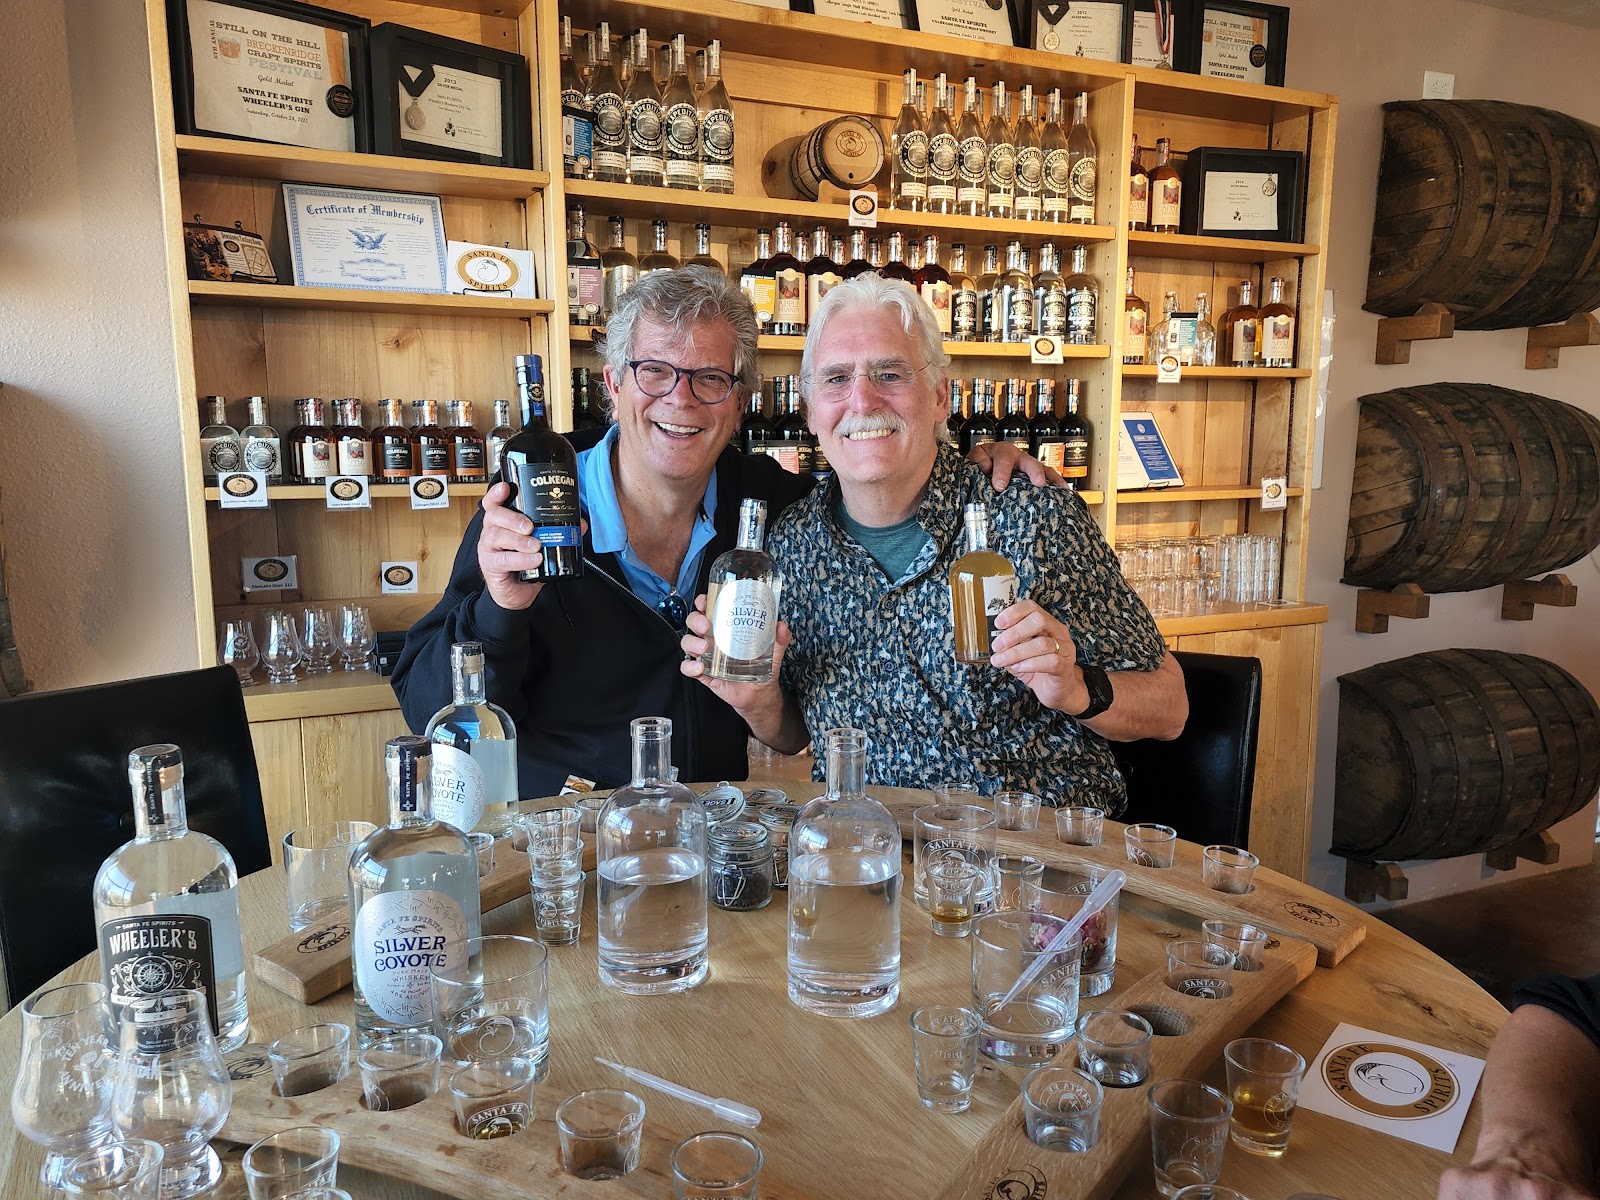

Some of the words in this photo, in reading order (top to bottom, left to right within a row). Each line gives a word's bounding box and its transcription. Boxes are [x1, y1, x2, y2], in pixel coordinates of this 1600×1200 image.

[941, 15, 958, 23] SANTA
[966, 19, 988, 28] SPIRITS
[216, 22, 249, 35] STILL
[252, 29, 267, 38] ON
[271, 33, 293, 44] THE
[296, 38, 321, 50] HILL
[1215, 35, 1233, 43] CRAFT
[246, 38, 322, 62] BRECKENRIDGE
[1216, 41, 1250, 53] FESTIVA
[247, 49, 281, 61] CRAFT
[283, 57, 322, 70] SPIRITS
[248, 57, 323, 80] FESTIVAL
[1230, 64, 1248, 72] SPIRITS
[257, 74, 273, 83] Gold
[274, 77, 294, 87] Medal
[237, 86, 266, 97] SANTA
[267, 91, 279, 100] FE
[280, 94, 313, 106] SPIRITS
[242, 96, 293, 111] WHEELER'S
[295, 106, 310, 114] GIN
[306, 204, 355, 216] Certificate
[358, 205, 368, 214] of
[368, 203, 425, 225] Membership
[467, 250, 496, 260] SANTA
[500, 254, 512, 265] FE
[468, 278, 508, 291] SPIRITS
[778, 300, 801, 308] APPLE
[530, 475, 575, 487] COLKEGAN
[728, 607, 768, 621] SILVER
[727, 617, 766, 630] COYOTE
[929, 838, 965, 852] SANTA
[966, 842, 980, 854] FE
[376, 918, 397, 937] SANTA
[411, 915, 444, 933] SPIRITS
[109, 928, 197, 956] WHEELER'S
[373, 936, 446, 956] SILVER
[374, 953, 447, 972] COYOTE
[391, 974, 430, 983] WHISKEY
[1040, 961, 1081, 988] SANTA
[1184, 980, 1217, 989] SANTA
[1217, 980, 1229, 989] FE
[516, 1000, 533, 1012] FE
[61, 1043, 81, 1064] TEN
[82, 1034, 110, 1049] YEAR
[1328, 1048, 1352, 1092] SANTA
[1350, 1044, 1373, 1057] FE
[1413, 1066, 1452, 1113] SPIRITS
[471, 1105, 508, 1125] SANTA
[508, 1103, 525, 1113] FE
